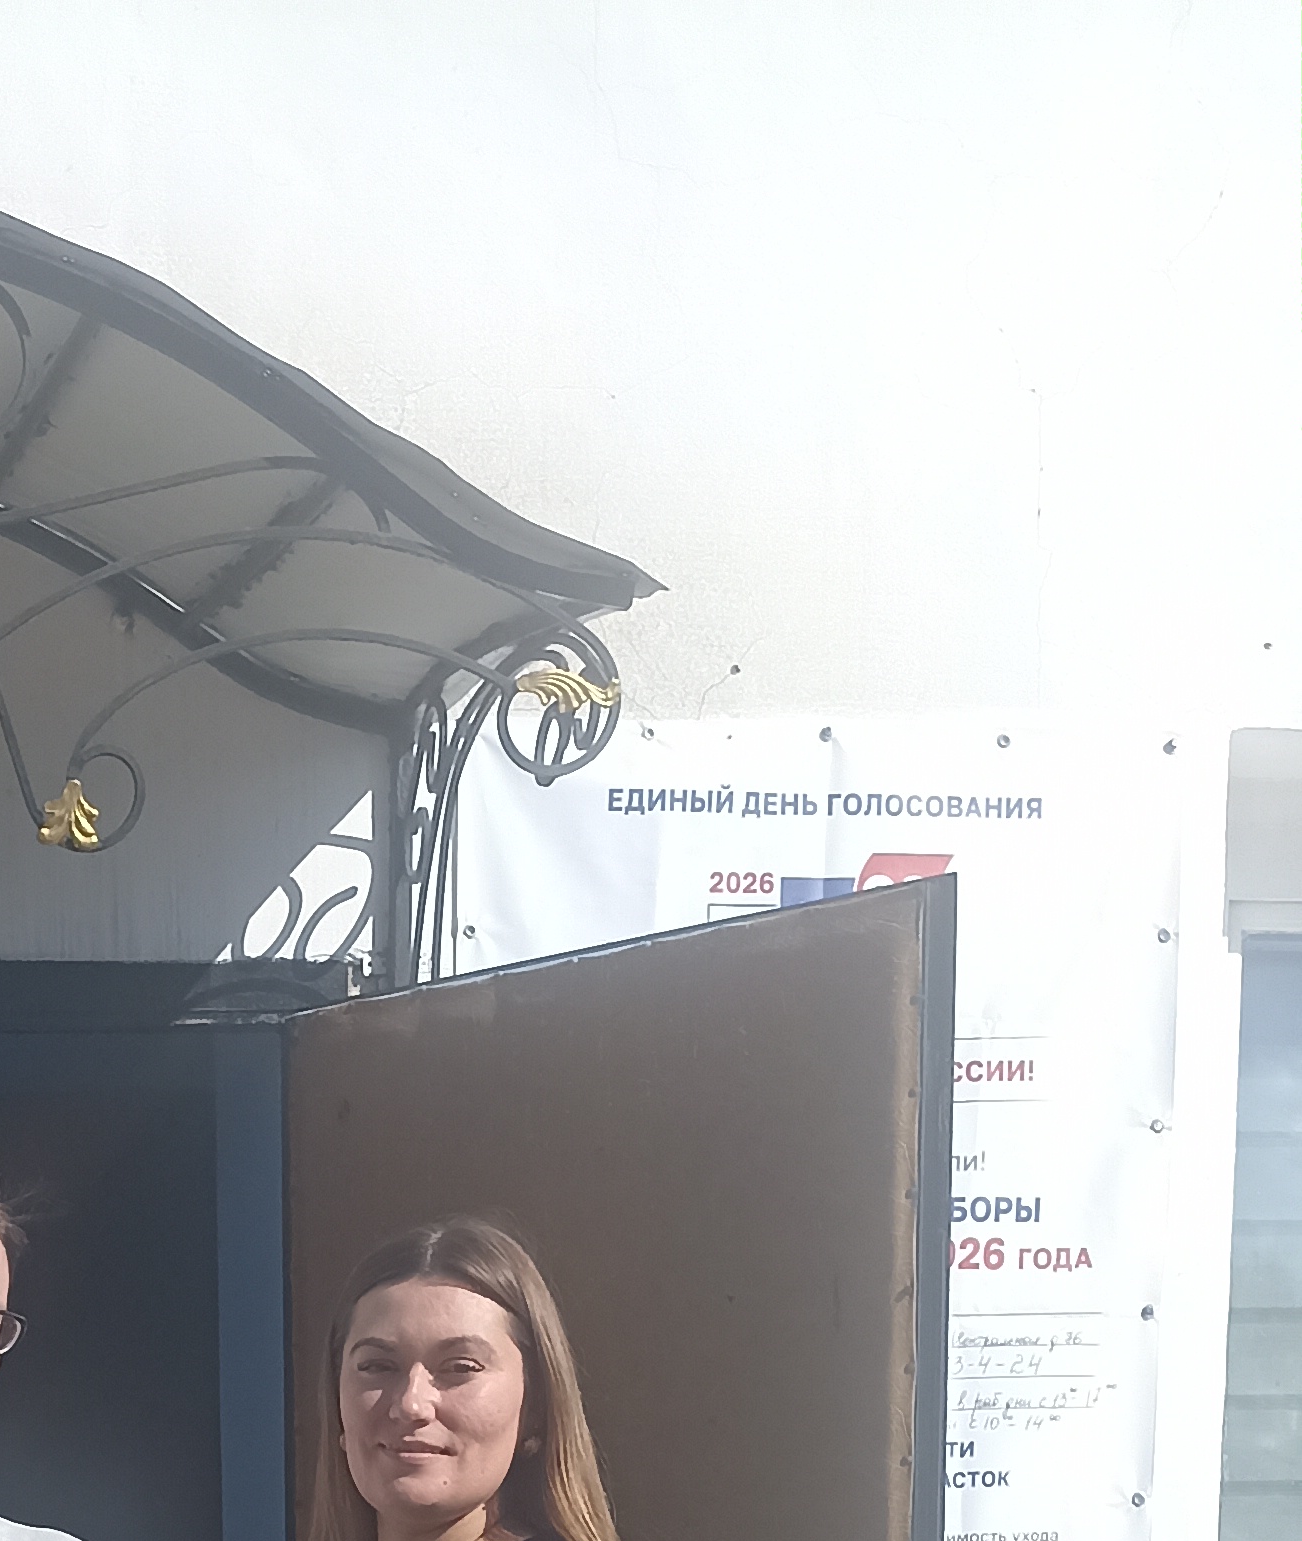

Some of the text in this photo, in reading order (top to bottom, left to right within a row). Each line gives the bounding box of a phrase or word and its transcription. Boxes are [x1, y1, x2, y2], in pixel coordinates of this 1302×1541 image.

[607, 785, 1043, 820] ЕДИНЫЙ ДЕНЬ ГОЛОСОВАНИЯ
[709, 872, 775, 895] 2026
[950, 1196, 1041, 1223] БОРЫ
[1018, 1247, 1093, 1273] ГОДА
[945, 1441, 975, 1458] ТИ
